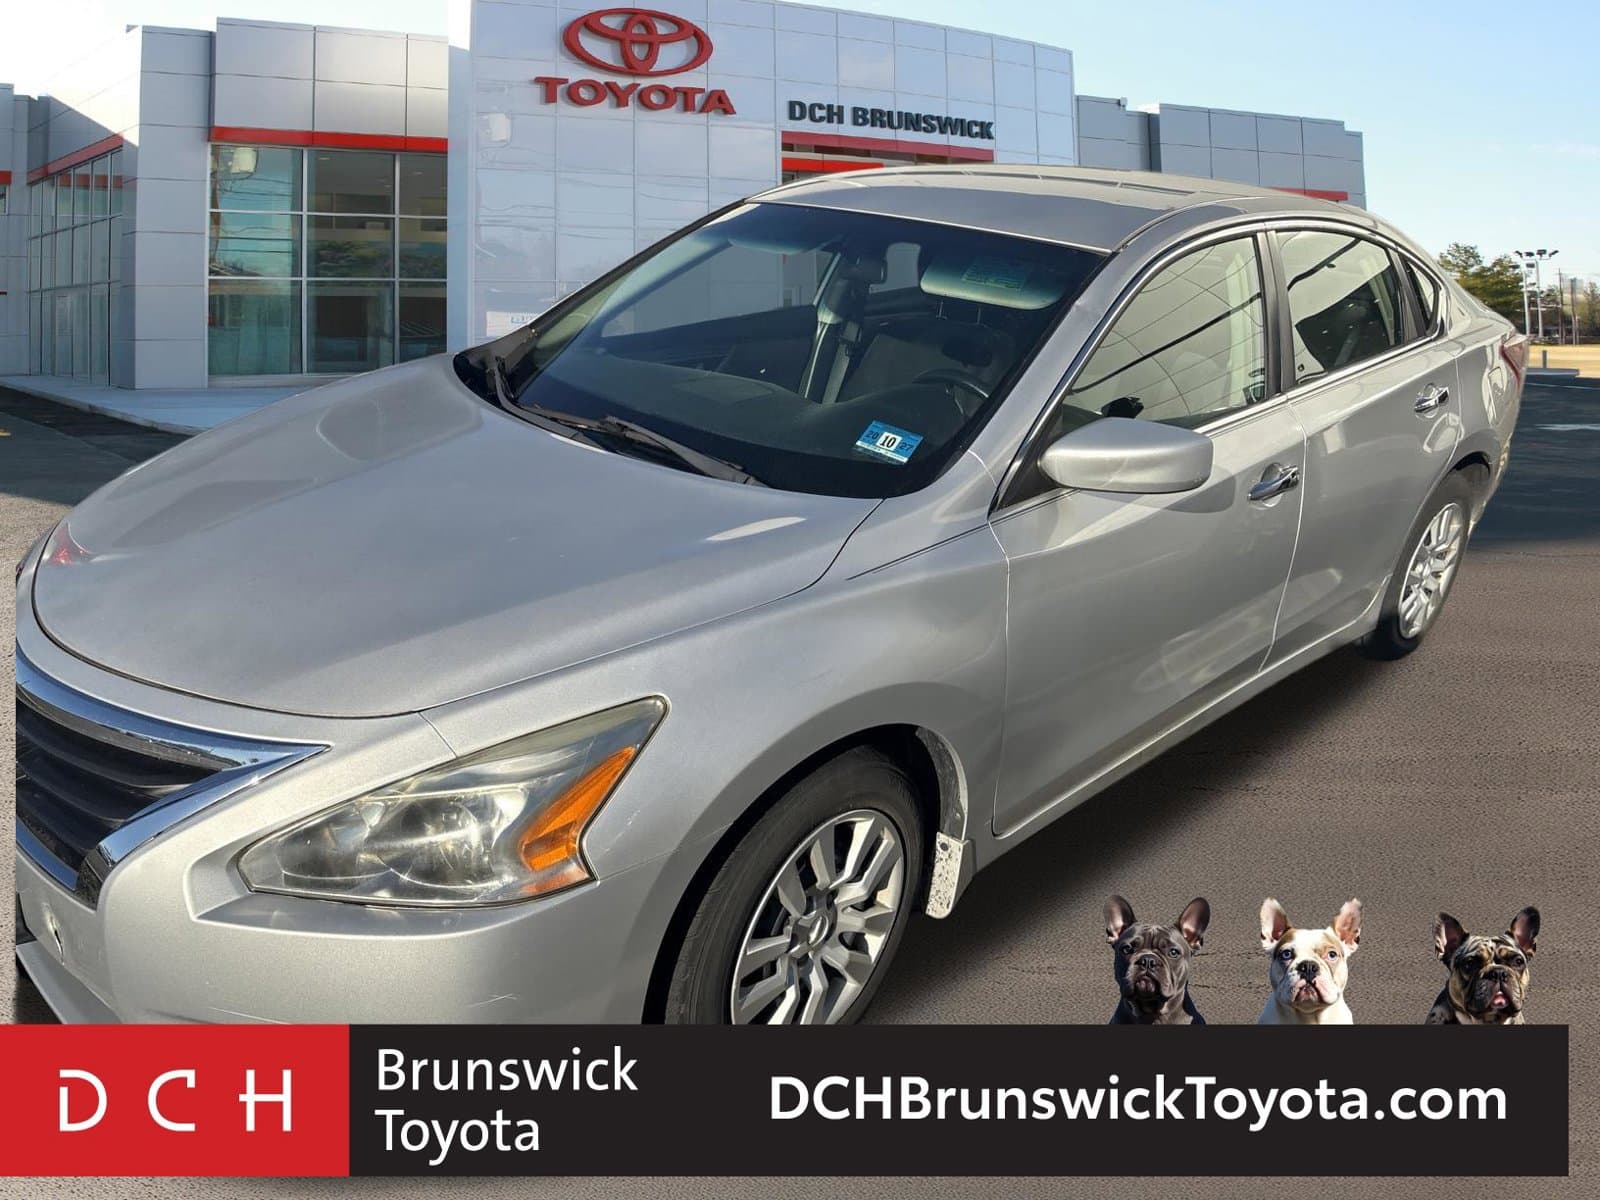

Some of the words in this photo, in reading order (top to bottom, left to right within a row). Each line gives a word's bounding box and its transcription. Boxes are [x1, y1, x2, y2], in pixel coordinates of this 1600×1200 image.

[535, 76, 736, 115] TOYOTA
[788, 100, 844, 125] DCH
[852, 106, 994, 140] BRUNSWICK
[866, 430, 880, 440] 20
[880, 434, 897, 448] 10
[898, 441, 914, 452] 27
